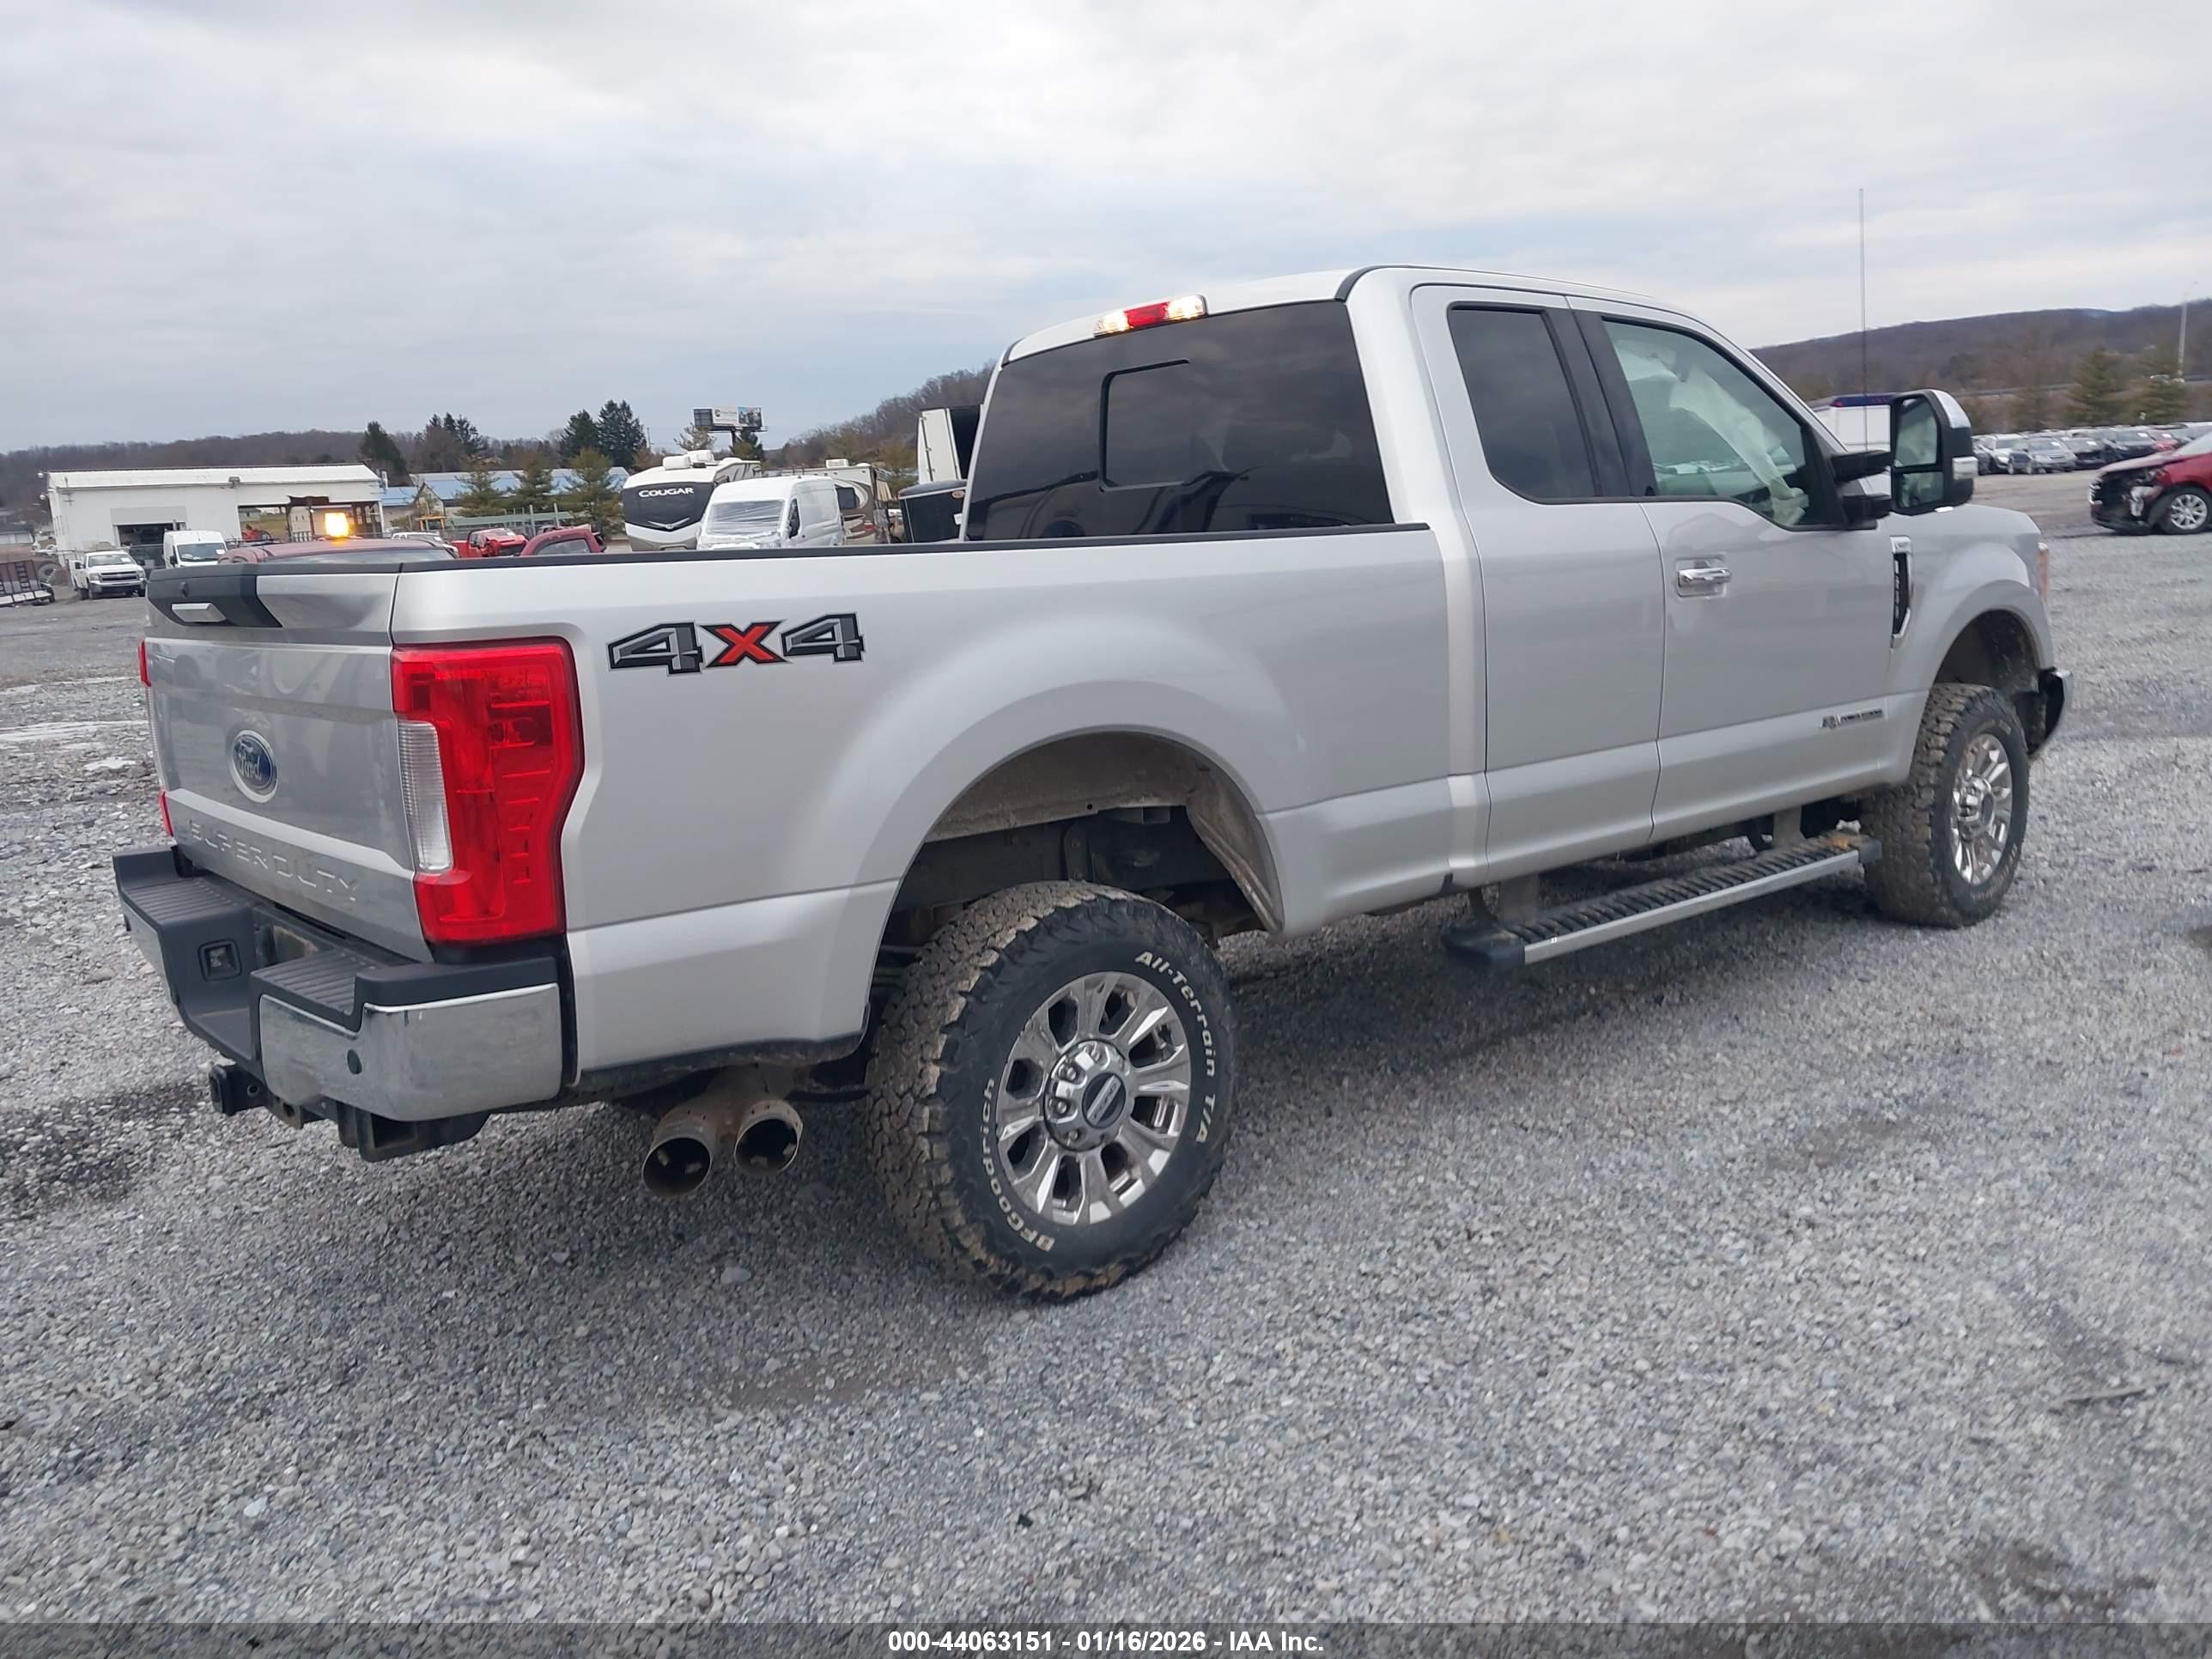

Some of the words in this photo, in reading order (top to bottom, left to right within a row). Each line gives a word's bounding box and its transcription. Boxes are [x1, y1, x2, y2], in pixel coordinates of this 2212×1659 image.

[638, 487, 695, 497] COUGAR
[234, 737, 265, 781] Ford
[272, 854, 359, 902] DUTY
[1134, 951, 1216, 1078] All-Terrain
[1195, 1092, 1216, 1143] T/A
[980, 1078, 1056, 1252] BFGoodrich
